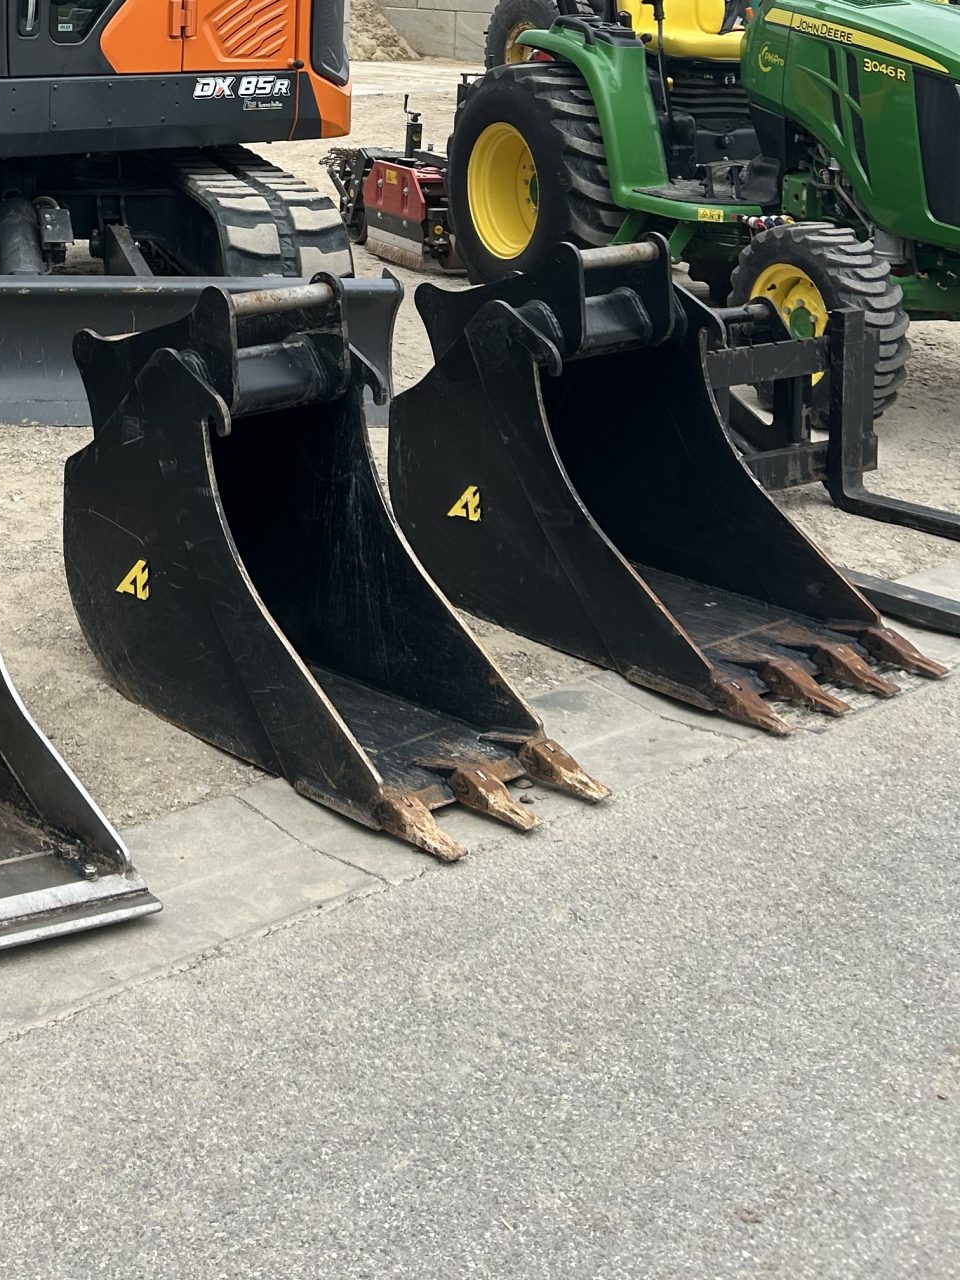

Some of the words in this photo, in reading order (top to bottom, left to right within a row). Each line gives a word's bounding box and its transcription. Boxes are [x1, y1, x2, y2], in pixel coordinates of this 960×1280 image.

[796, 17, 820, 35] JOHN
[820, 23, 853, 43] DEERE
[193, 76, 236, 99] DX
